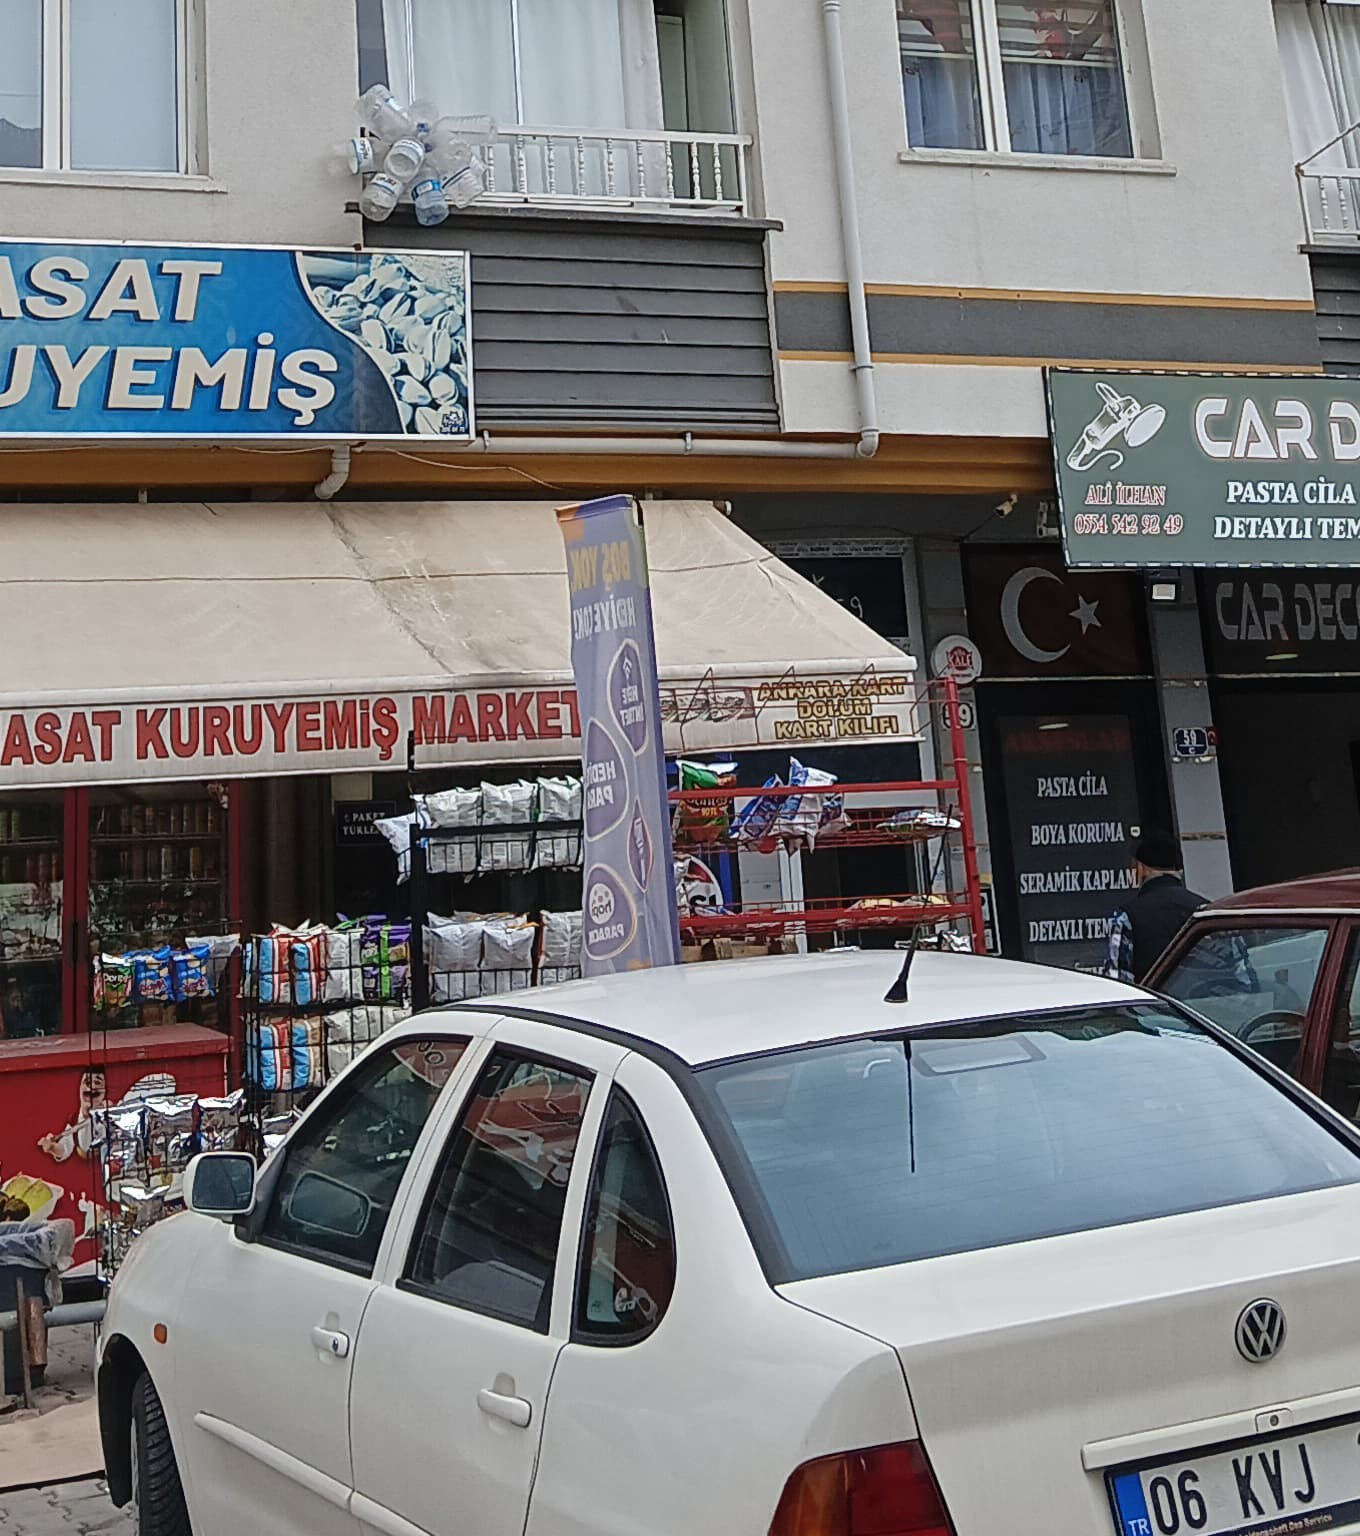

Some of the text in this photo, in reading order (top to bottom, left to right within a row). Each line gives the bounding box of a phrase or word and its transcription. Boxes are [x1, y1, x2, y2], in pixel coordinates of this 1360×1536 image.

[1193, 397, 1318, 460] CAR
[1085, 481, 1166, 505] ALİ İLHAN
[1226, 482, 1298, 505] PASTA
[1303, 477, 1356, 505] CİLA
[1074, 514, 1183, 534] 0554 542 92 49
[1214, 516, 1313, 539] DETAYLI
[1216, 583, 1288, 641] CAR
[758, 677, 907, 701] ANKARA KART
[797, 698, 872, 718] DOLUM
[135, 700, 398, 761] KURUYEMİŞ
[413, 690, 581, 745] MARKET
[775, 716, 898, 739] KART KILIFI
[1183, 730, 1197, 745] 59
[1037, 770, 1108, 797] PASTA CİLA
[1031, 822, 1125, 845] BOYA KORUMA
[1020, 865, 1139, 894] SERAMİK KAPLAM
[1029, 920, 1084, 942] DETAYLI
[1149, 1470, 1208, 1536] 06
[1232, 1443, 1316, 1518] KVJ
